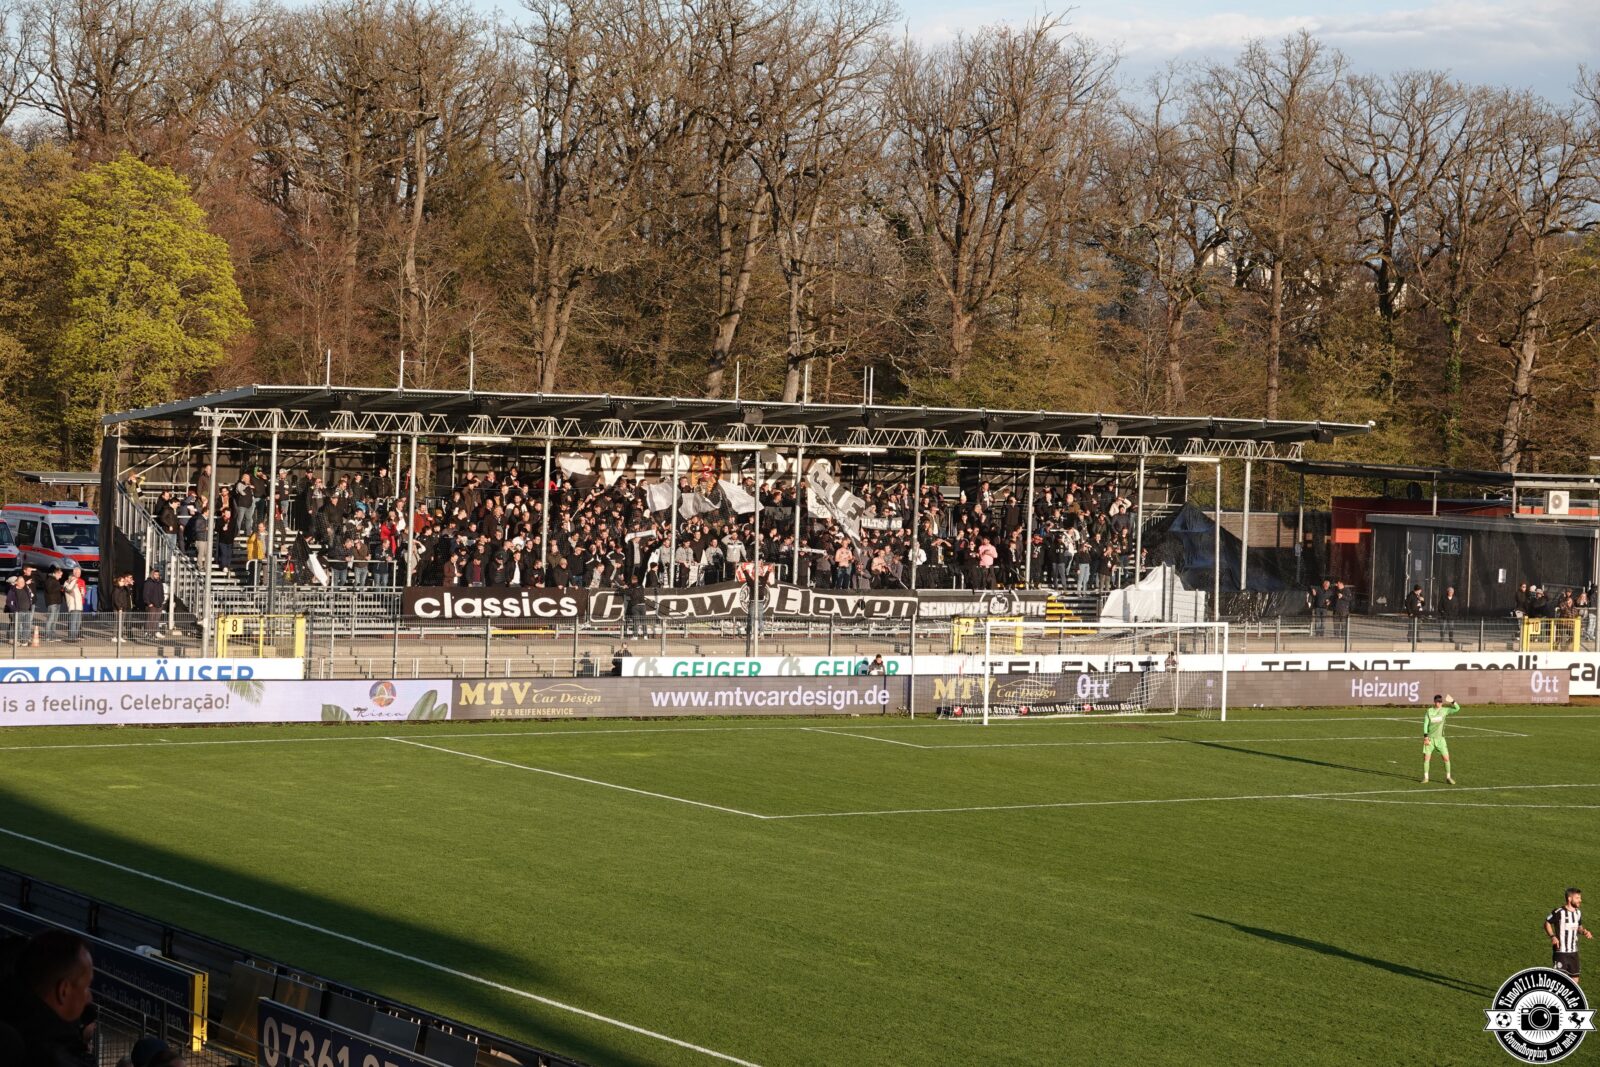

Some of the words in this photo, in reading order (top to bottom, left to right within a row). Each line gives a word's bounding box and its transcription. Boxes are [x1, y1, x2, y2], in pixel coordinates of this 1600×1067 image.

[414, 592, 578, 618] classics
[589, 588, 738, 622] Cew
[774, 585, 919, 620] Eleven
[919, 601, 988, 616] SCHWARZE
[1012, 600, 1047, 616] ELITE
[231, 619, 238, 633] 8
[1530, 621, 1540, 633] 10
[672, 661, 762, 677] GEIGER
[933, 677, 997, 700] MTV
[996, 688, 1018, 698] Car
[1020, 687, 1057, 699] Design
[1076, 673, 1110, 698] Ott
[1351, 676, 1420, 702] Heizung
[1530, 670, 1559, 693] Ott
[3, 697, 18, 712] is
[25, 699, 35, 712] a
[42, 694, 113, 715] feeling.
[120, 693, 230, 713] Celebração!
[458, 682, 532, 706] MTV
[532, 693, 557, 704] Car
[560, 692, 602, 705] Design
[651, 685, 890, 710] www.mtvcardesign.de
[490, 708, 506, 717] KFZ
[514, 707, 574, 717] REIFENSERVICE
